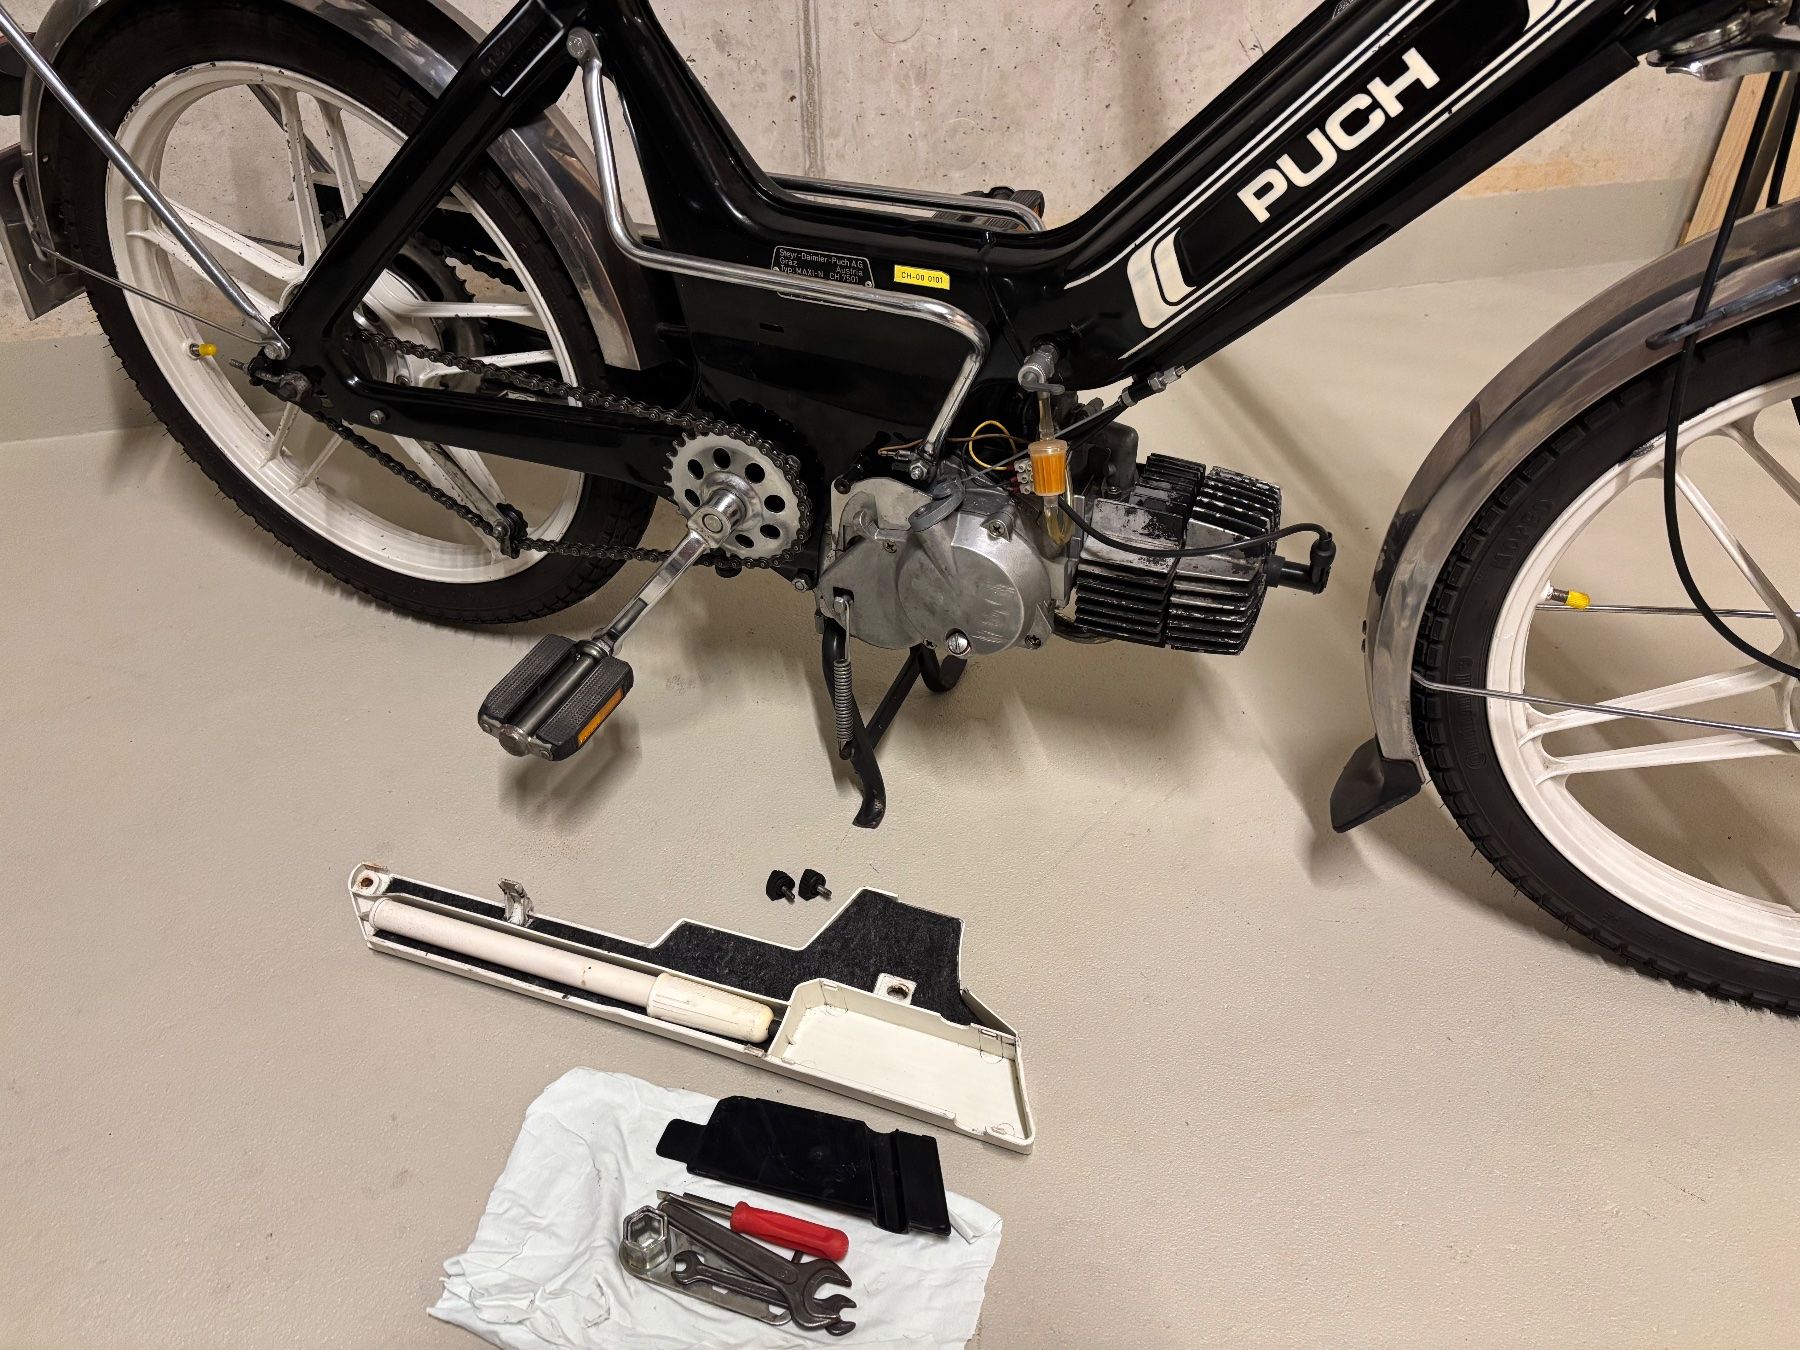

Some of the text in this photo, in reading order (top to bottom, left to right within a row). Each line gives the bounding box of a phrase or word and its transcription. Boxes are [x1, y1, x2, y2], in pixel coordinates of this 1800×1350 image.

[1236, 47, 1440, 224] PUCH
[779, 249, 850, 268] Steyr-Daimler-Puch
[779, 257, 864, 277] Graz Austria
[795, 267, 824, 277] MAXI-N
[829, 272, 840, 281] CH
[841, 273, 859, 283] 7501
